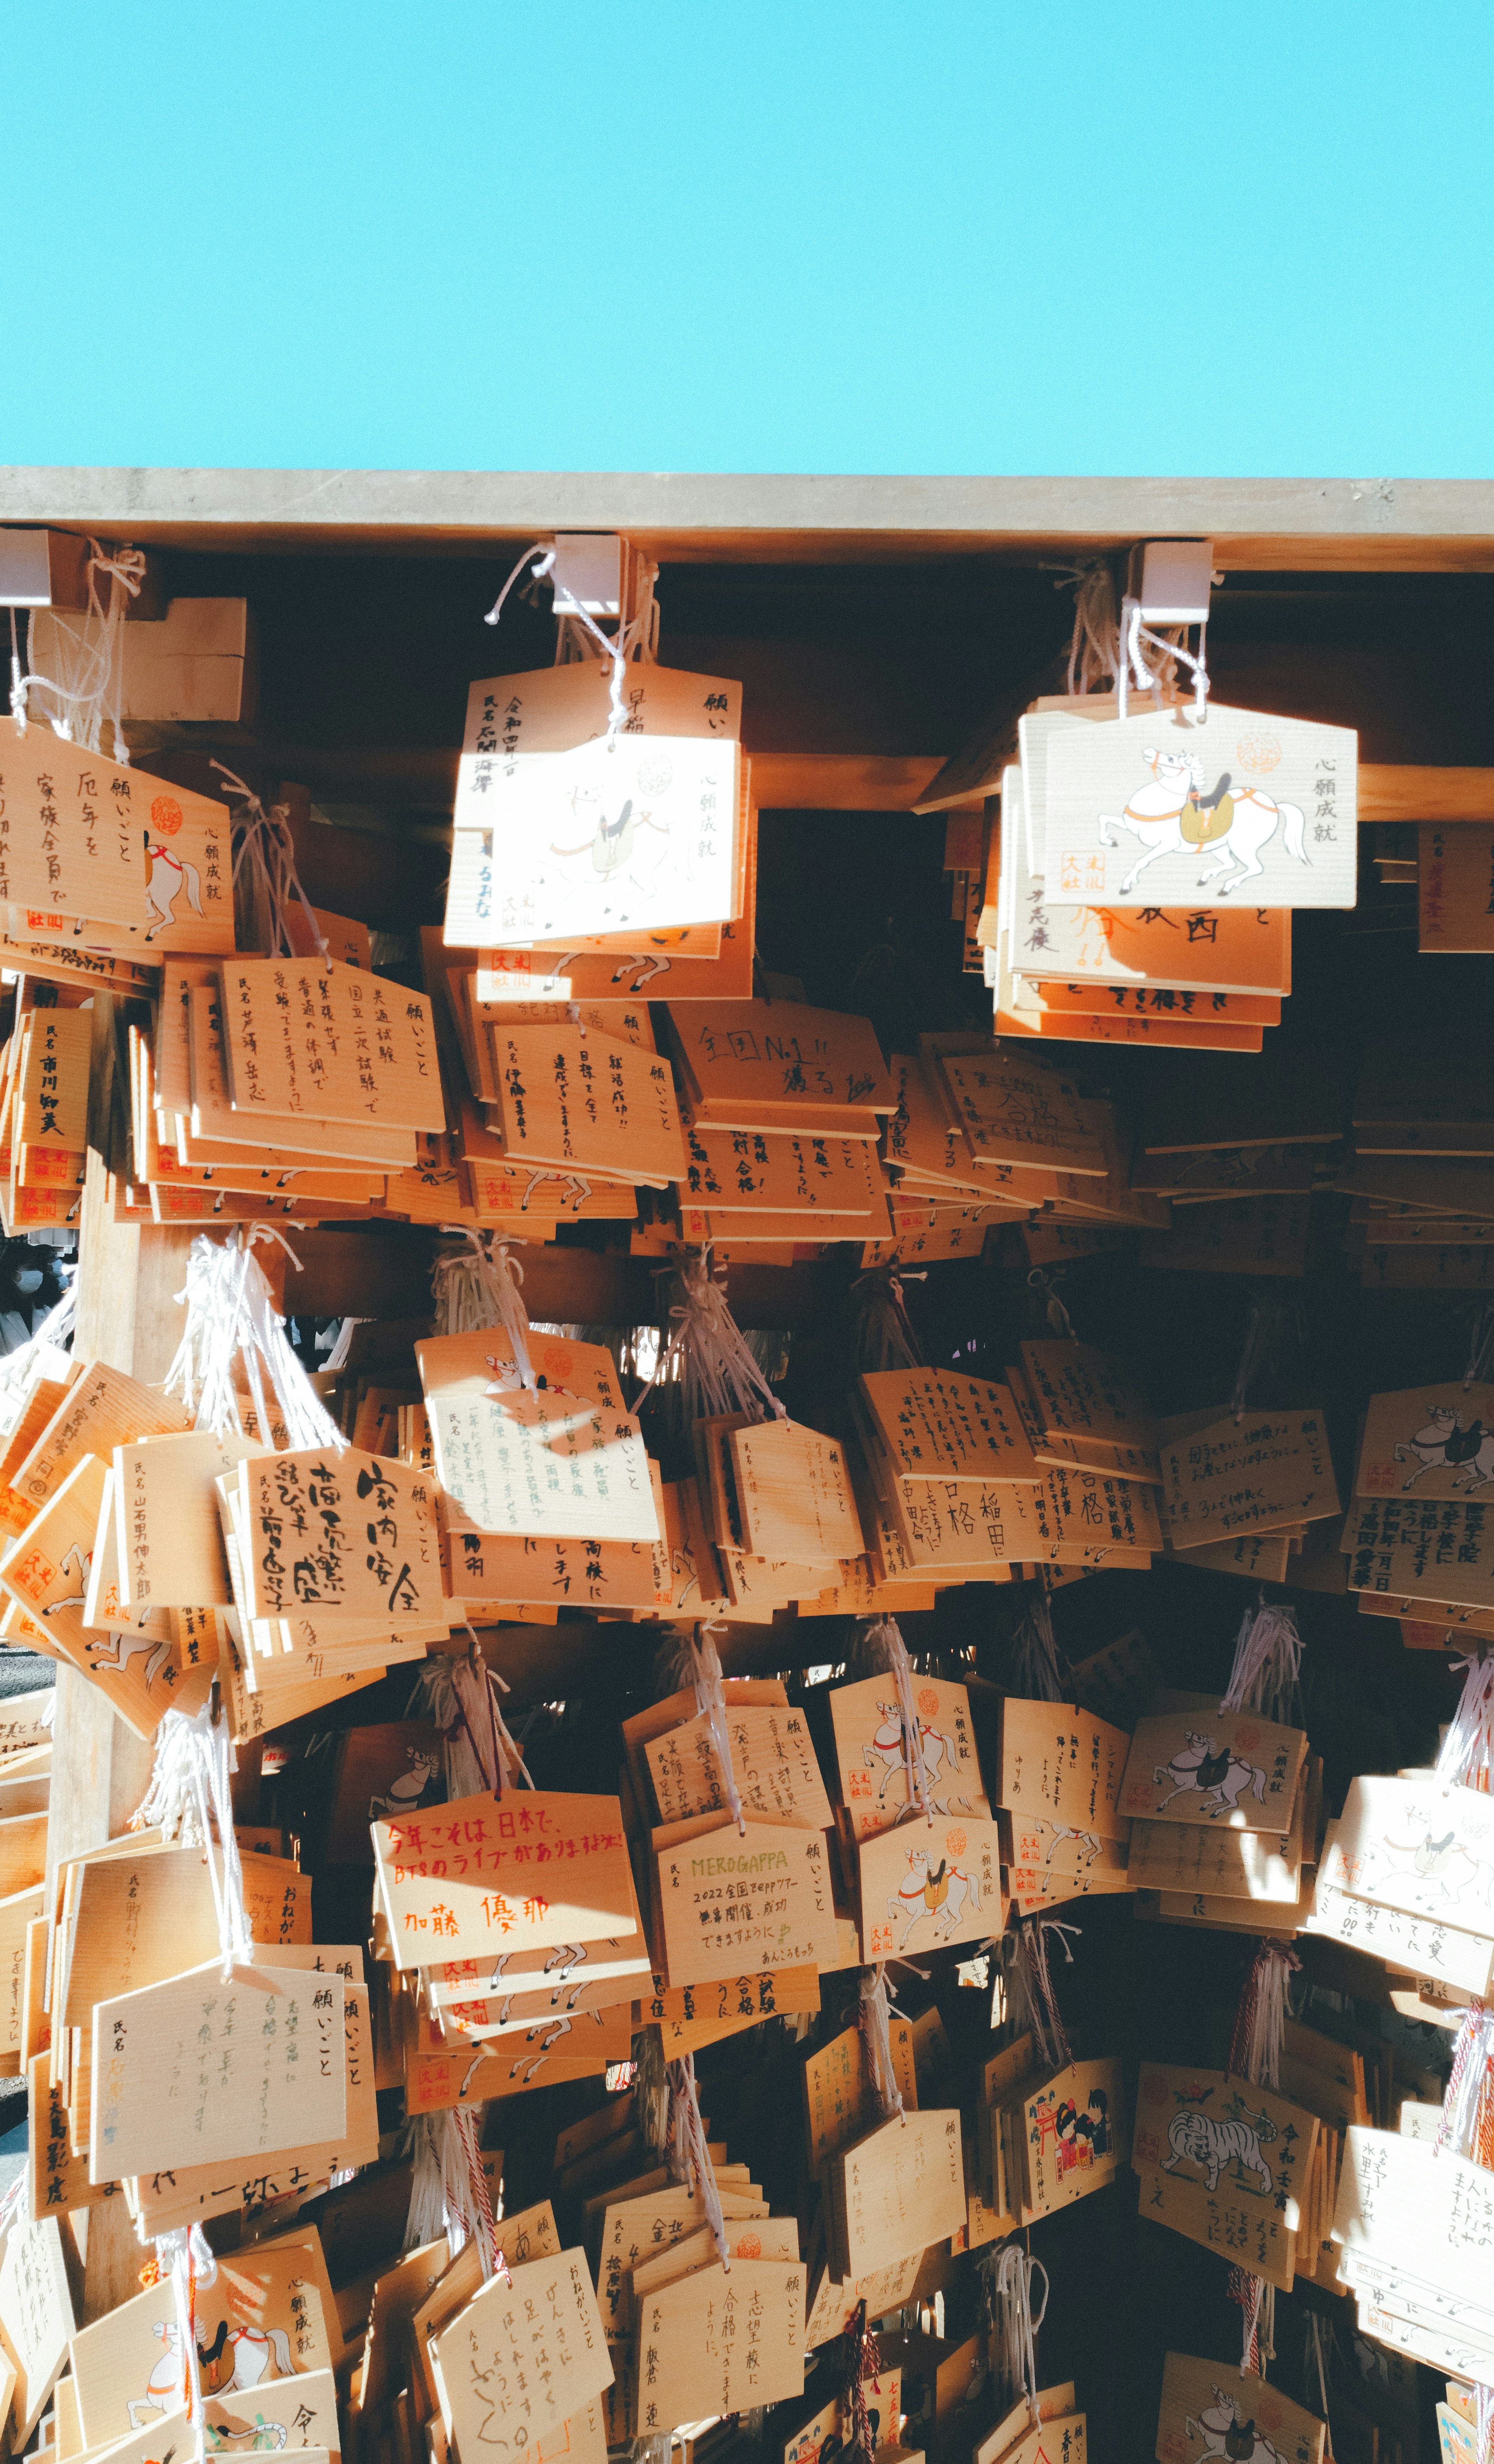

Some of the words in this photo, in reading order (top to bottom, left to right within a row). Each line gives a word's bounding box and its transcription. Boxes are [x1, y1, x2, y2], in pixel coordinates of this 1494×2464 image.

[78, 772, 98, 856] 厄年を
[110, 778, 130, 862] 願いごと
[699, 774, 717, 858] 心願成就
[1313, 759, 1337, 842] 心願成就
[37, 773, 67, 902] 家族全員で
[205, 828, 221, 899] 心願成就
[239, 978, 250, 1004] 氏名
[46, 1026, 58, 1049] 氏名
[406, 1004, 428, 1076] 願いごと
[508, 1041, 517, 1063] 氏名
[650, 1066, 670, 1130] 願いごと
[593, 1369, 615, 1408] 心願成
[449, 1413, 460, 1436] 氏名
[1302, 1421, 1322, 1474] 願いごと
[135, 1463, 146, 1489] 氏名
[615, 1424, 640, 1490] 願いごと
[829, 1450, 845, 1512] 願いごと
[260, 1476, 270, 1502] 氏名
[356, 1462, 421, 1611] 家内安全
[412, 1486, 430, 1563] 願いごと
[979, 1482, 1005, 1557] 稲田に
[787, 1719, 813, 1781] 願いごと
[954, 1706, 970, 1759] 心願成就
[658, 1753, 670, 1776] 氏名
[1270, 1745, 1289, 1793] 心願成就
[129, 1874, 139, 1898] 氏名
[670, 1864, 680, 1888] 氏名
[805, 1843, 825, 1912] 願いごと
[981, 1842, 994, 1896] 心願成就
[403, 1904, 460, 1936] 加藤
[114, 2020, 127, 2051] 氏名
[312, 1989, 333, 2077] 願いごと
[898, 2031, 911, 2090] 願いごと
[852, 2163, 859, 2185] 氏名
[945, 2121, 957, 2182] 願いごと
[1274, 2124, 1299, 2211] 令和壬寅
[1380, 2149, 1387, 2166] 氏名
[615, 2219, 623, 2243] 氏名
[288, 2276, 316, 2355] 心願成就
[570, 2266, 593, 2350] おねがいごと
[653, 2308, 661, 2333] 氏名
[745, 2290, 762, 2385] 志望校に
[786, 2276, 798, 2346] 願いごと
[469, 2331, 479, 2352] 氏名
